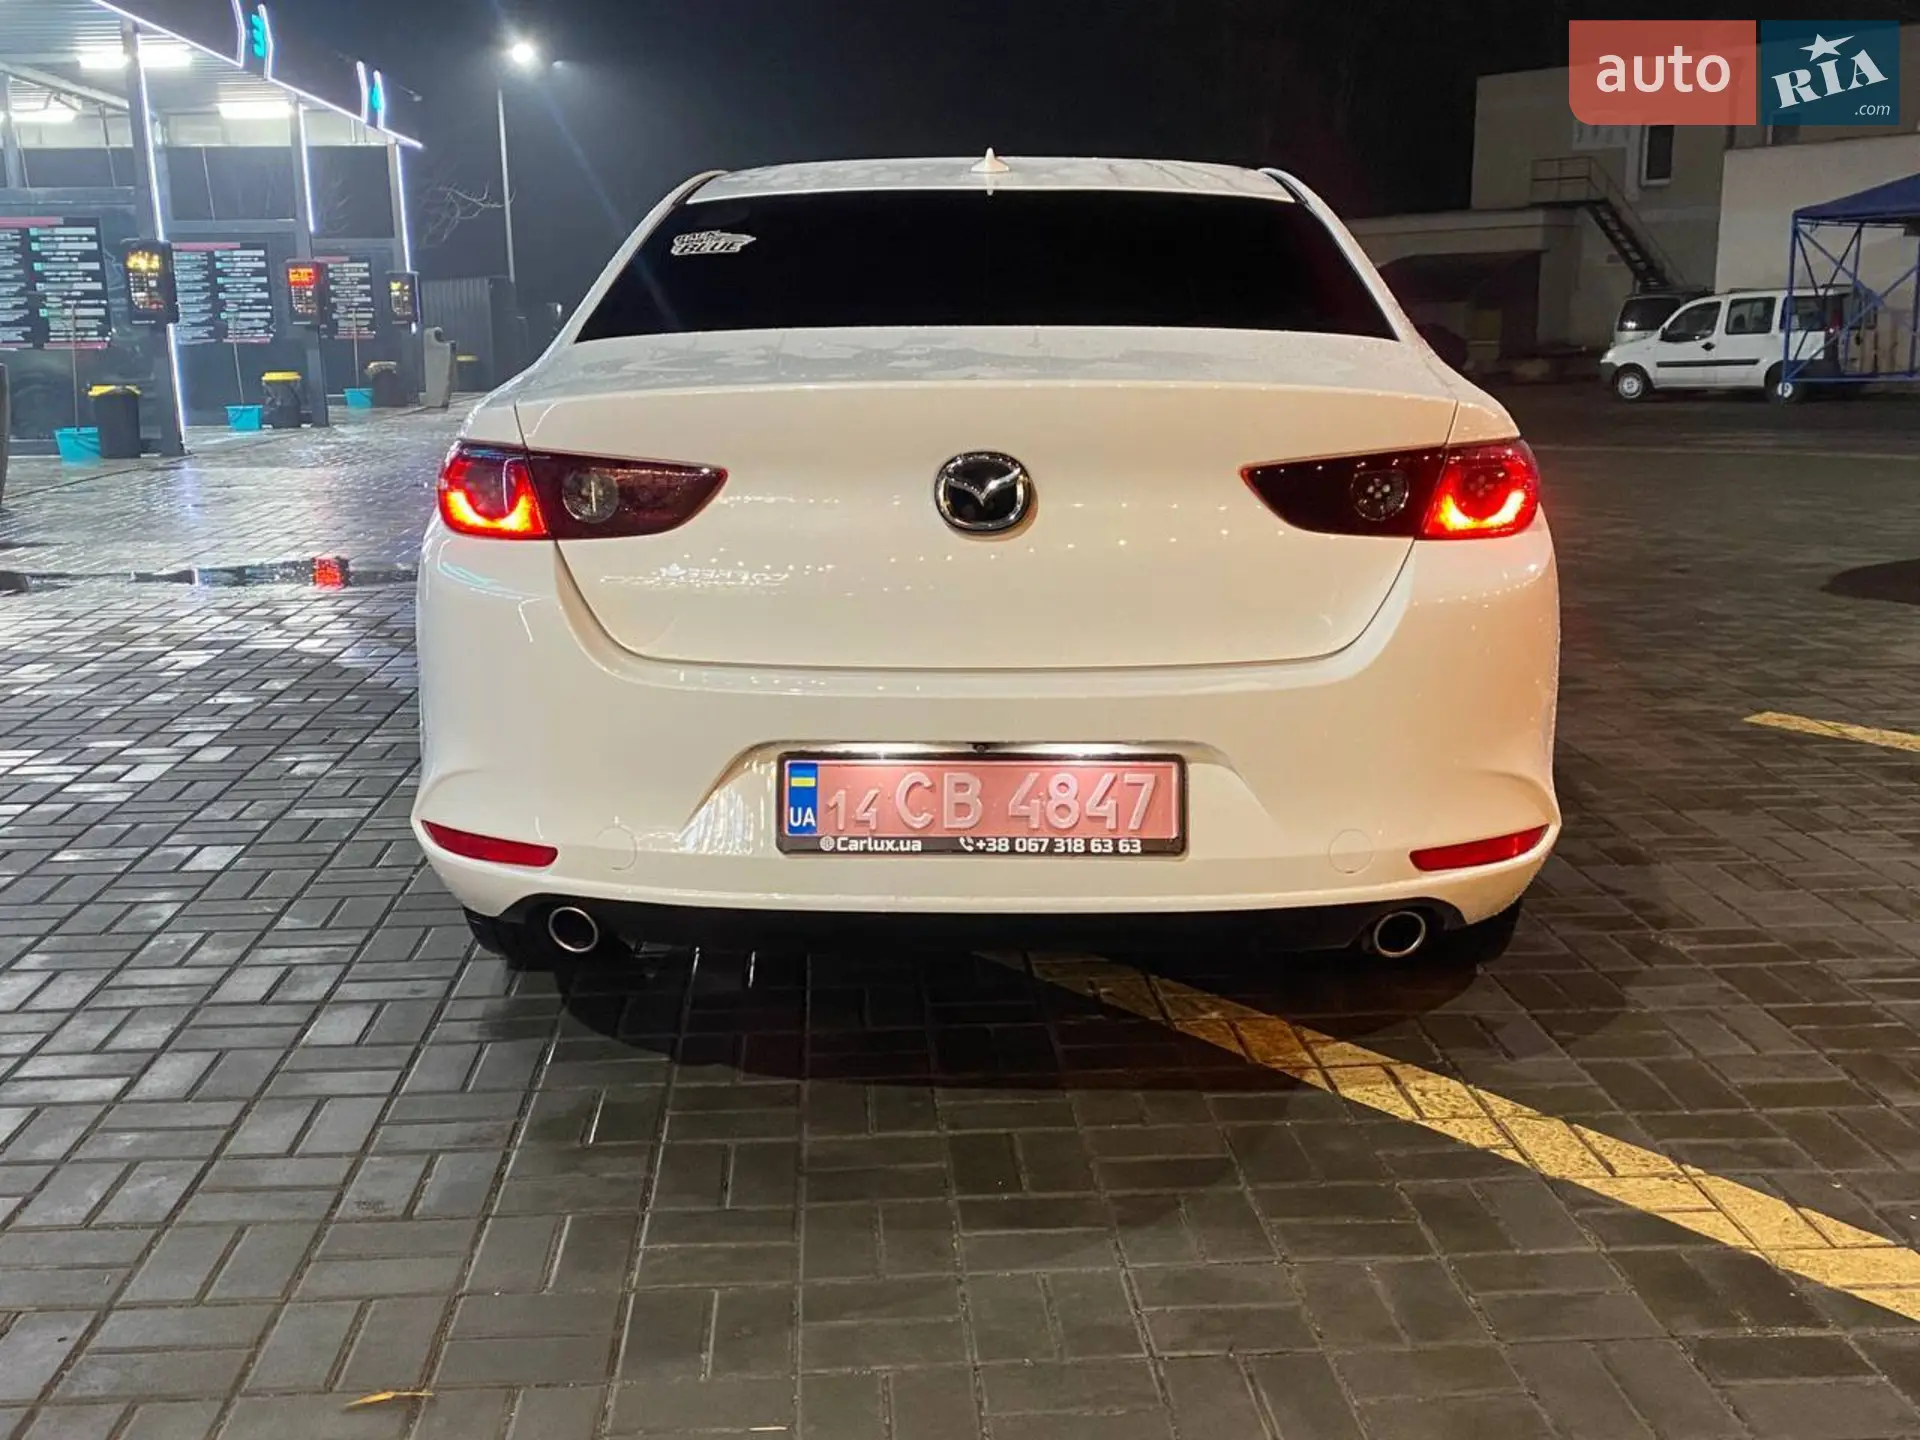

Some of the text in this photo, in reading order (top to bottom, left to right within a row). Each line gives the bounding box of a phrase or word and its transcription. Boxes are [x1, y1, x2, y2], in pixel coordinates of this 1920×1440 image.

[827, 771, 1157, 831] 14 CB 4847
[789, 806, 816, 827] UA
[836, 836, 922, 852] Carlux.ua
[976, 837, 1142, 853] +38 067 318 63 63
